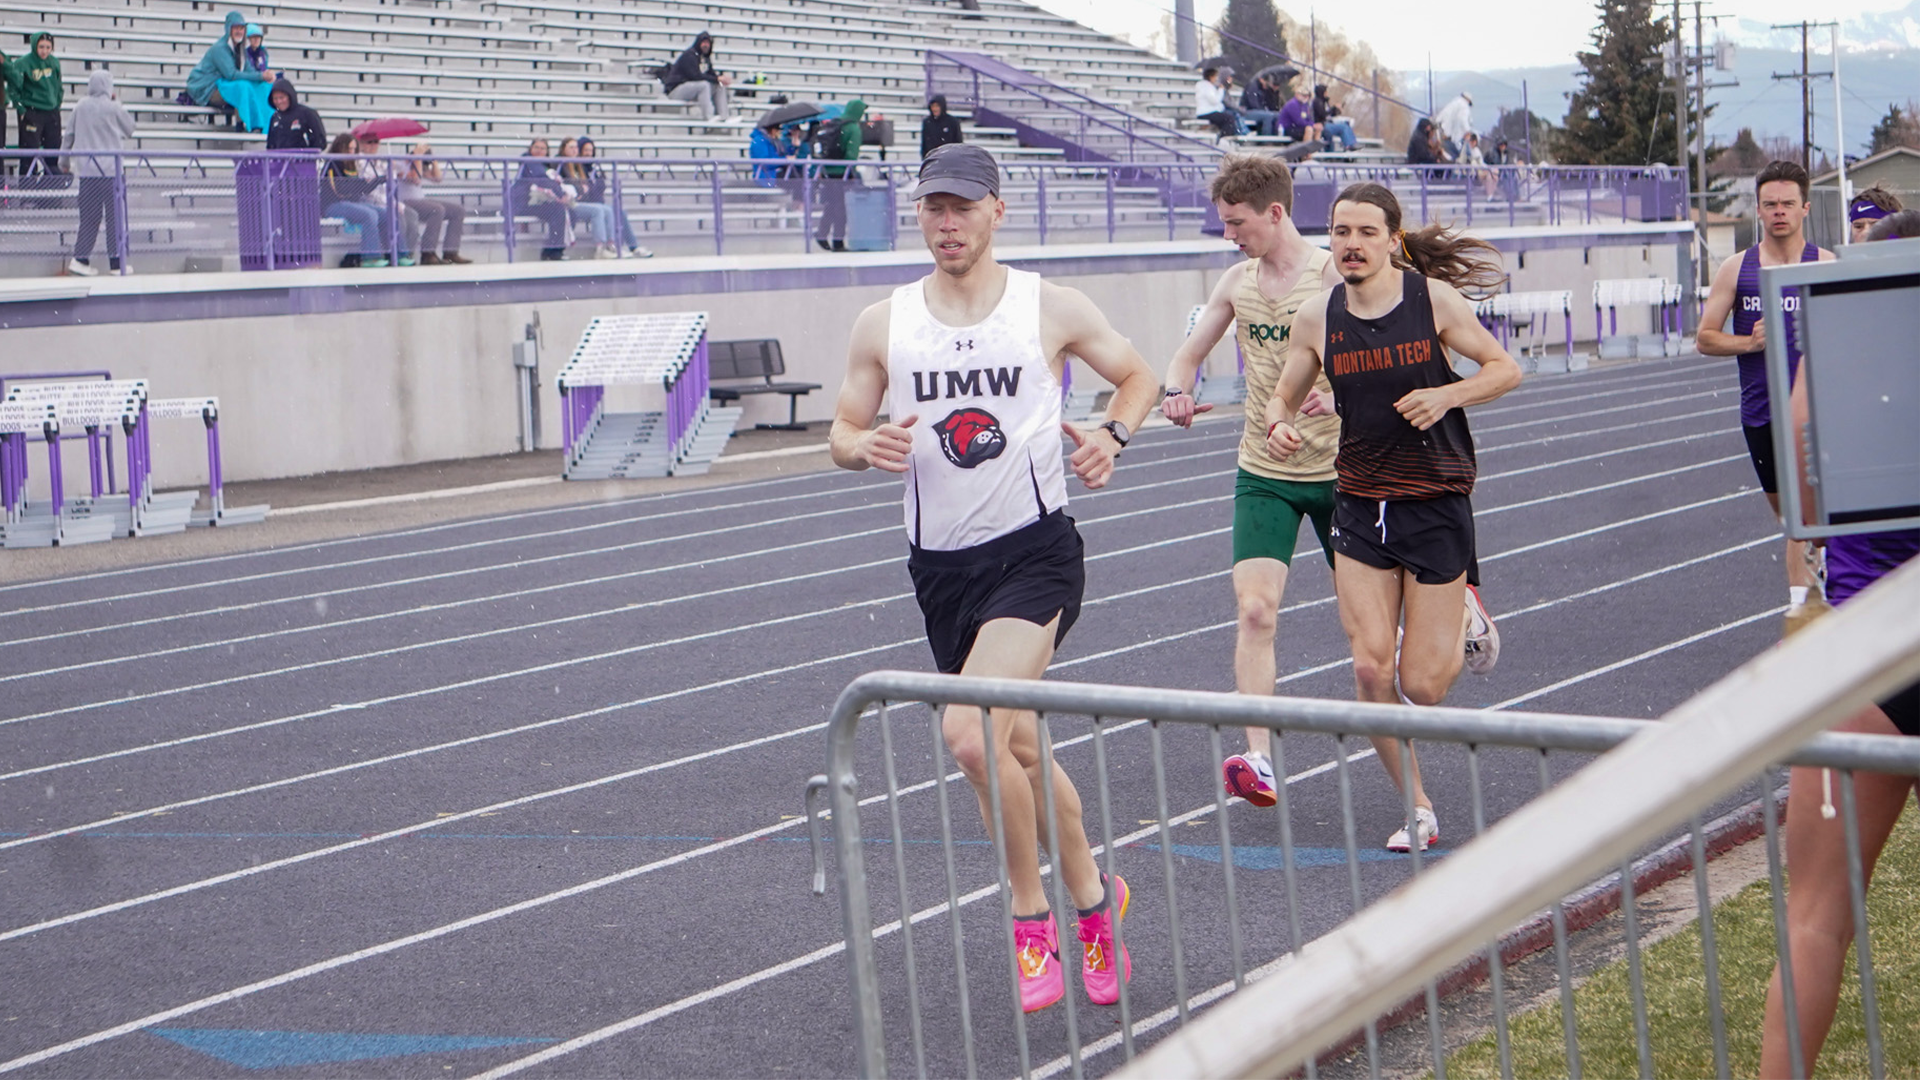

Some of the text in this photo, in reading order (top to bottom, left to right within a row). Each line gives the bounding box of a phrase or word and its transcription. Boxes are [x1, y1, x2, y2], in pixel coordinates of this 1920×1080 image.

[1332, 339, 1431, 376] MONTANA TECH
[912, 366, 1022, 402] UMW
[62, 416, 100, 426] BULLDOGS
